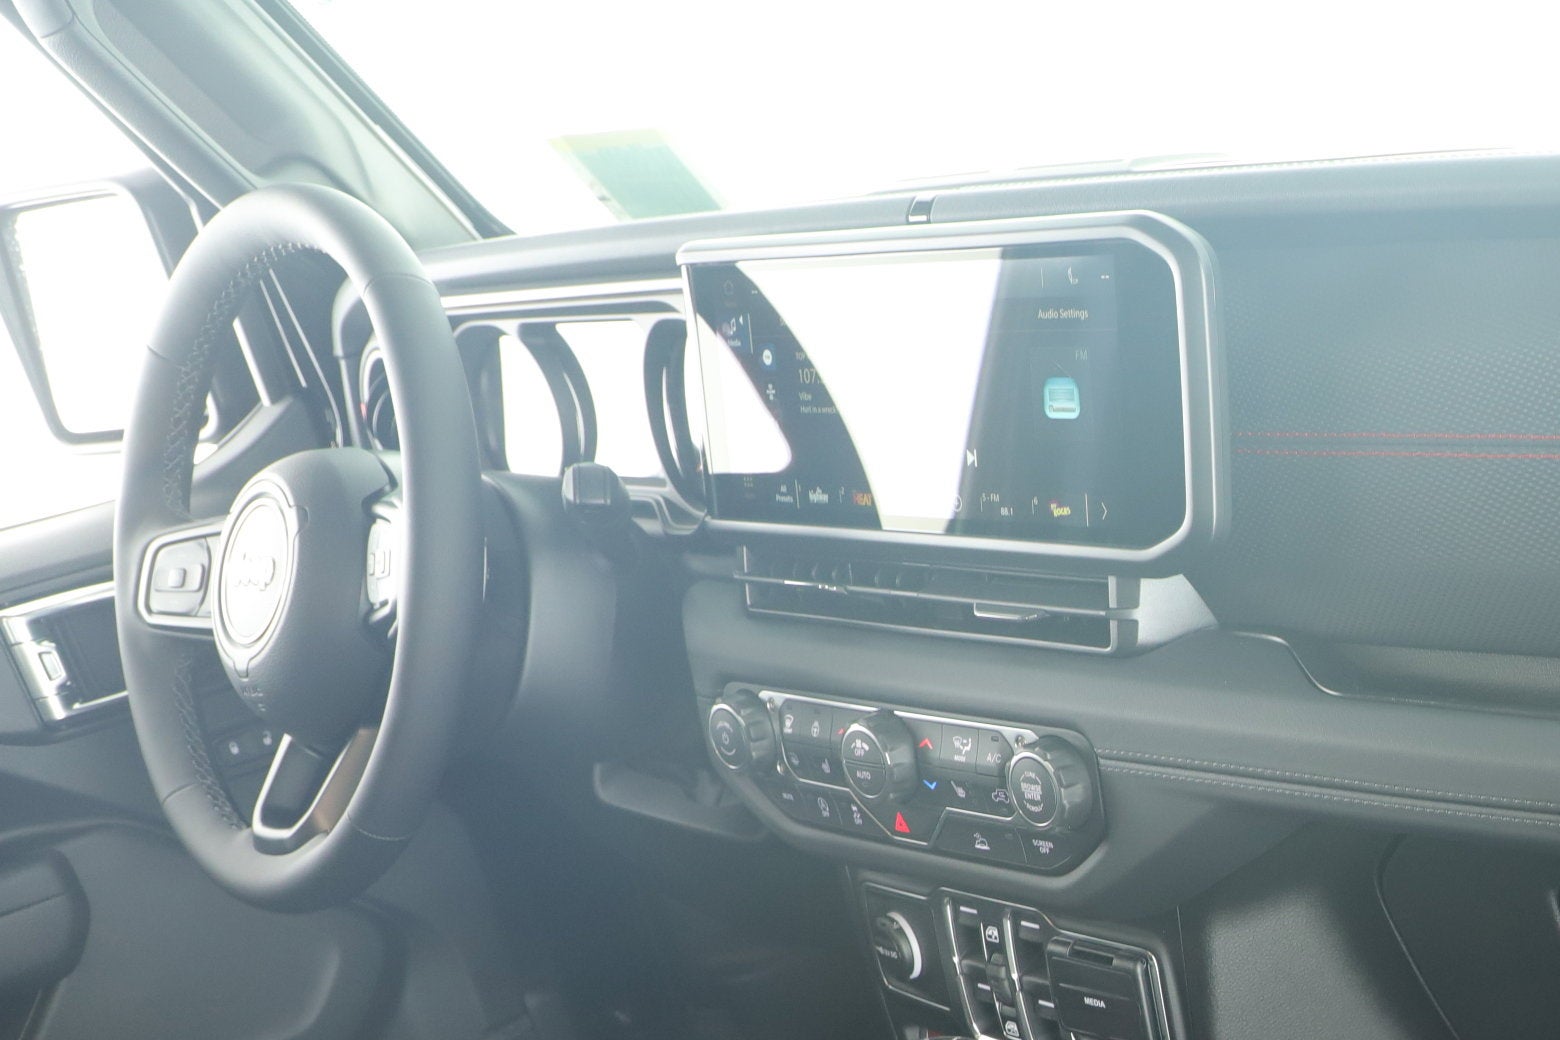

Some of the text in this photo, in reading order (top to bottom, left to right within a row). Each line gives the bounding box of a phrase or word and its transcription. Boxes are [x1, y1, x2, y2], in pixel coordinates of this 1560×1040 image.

[1038, 308, 1089, 321] Audio Settings
[1075, 350, 1088, 361] FM
[1000, 506, 1013, 517] 88.1
[854, 748, 865, 758] OFF
[986, 752, 1001, 763] A/C
[856, 769, 872, 780] AUTO
[1020, 782, 1042, 794] BROWSE
[1024, 791, 1041, 801] ENTER
[1032, 838, 1054, 850] SCREEN
[1039, 846, 1050, 856] OFF
[1084, 996, 1106, 1009] MEDIA
